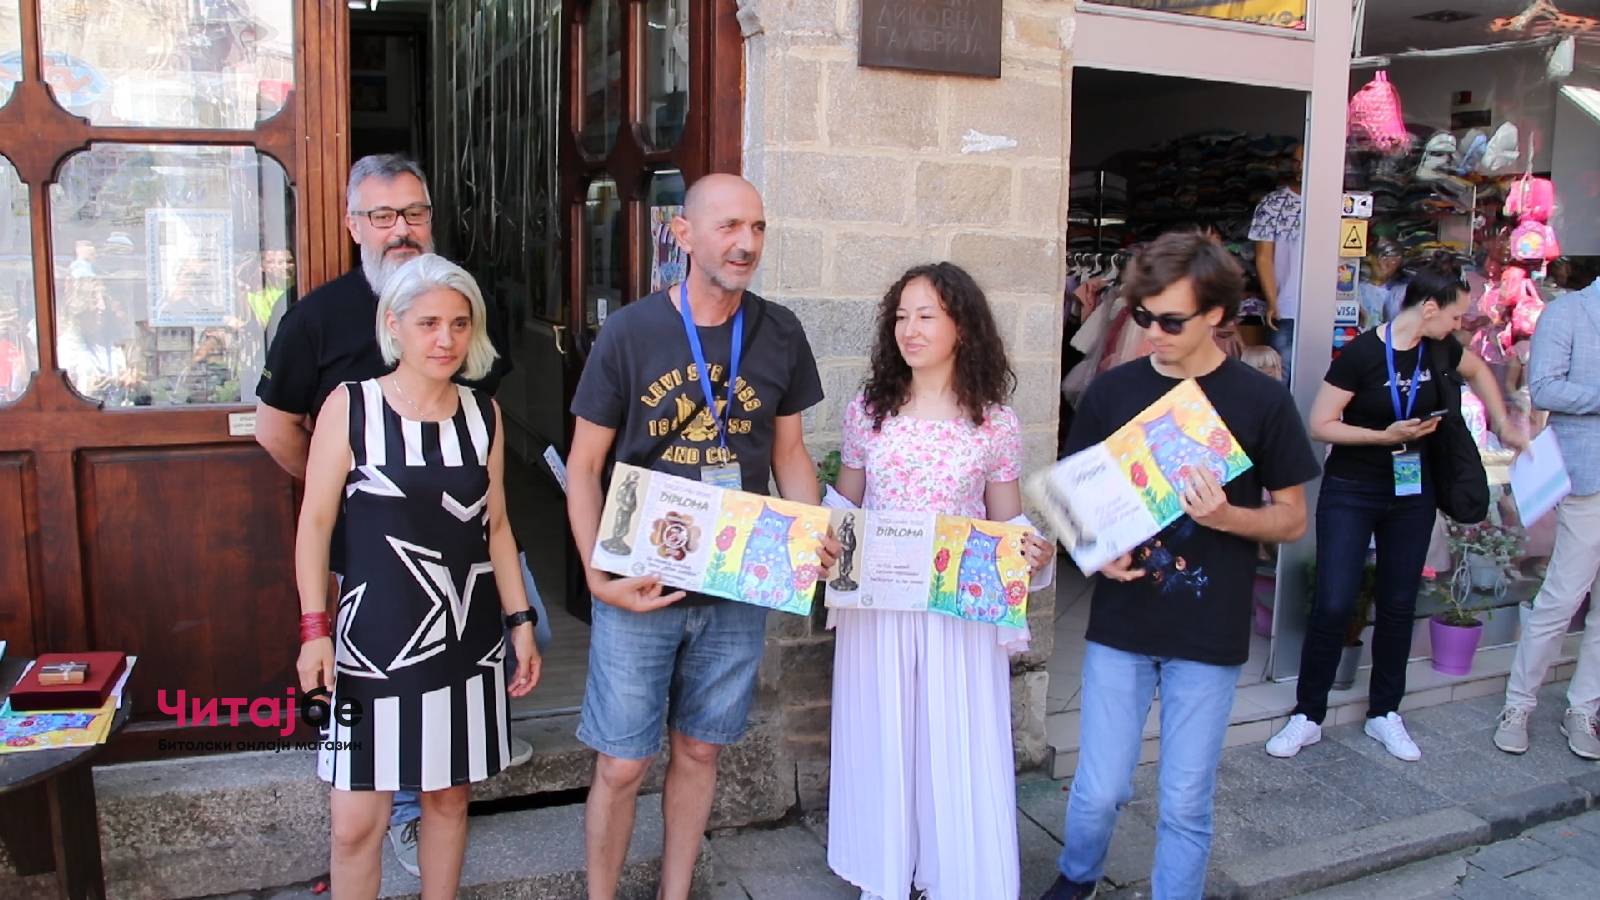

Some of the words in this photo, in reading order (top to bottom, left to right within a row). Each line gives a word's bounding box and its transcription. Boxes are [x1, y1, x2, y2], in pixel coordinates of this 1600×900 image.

[1336, 306, 1357, 316] VISA
[640, 368, 683, 407] LEVI
[661, 445, 700, 464] AND
[659, 490, 709, 512] DIPLOMA
[876, 525, 924, 537] DIPLOMA
